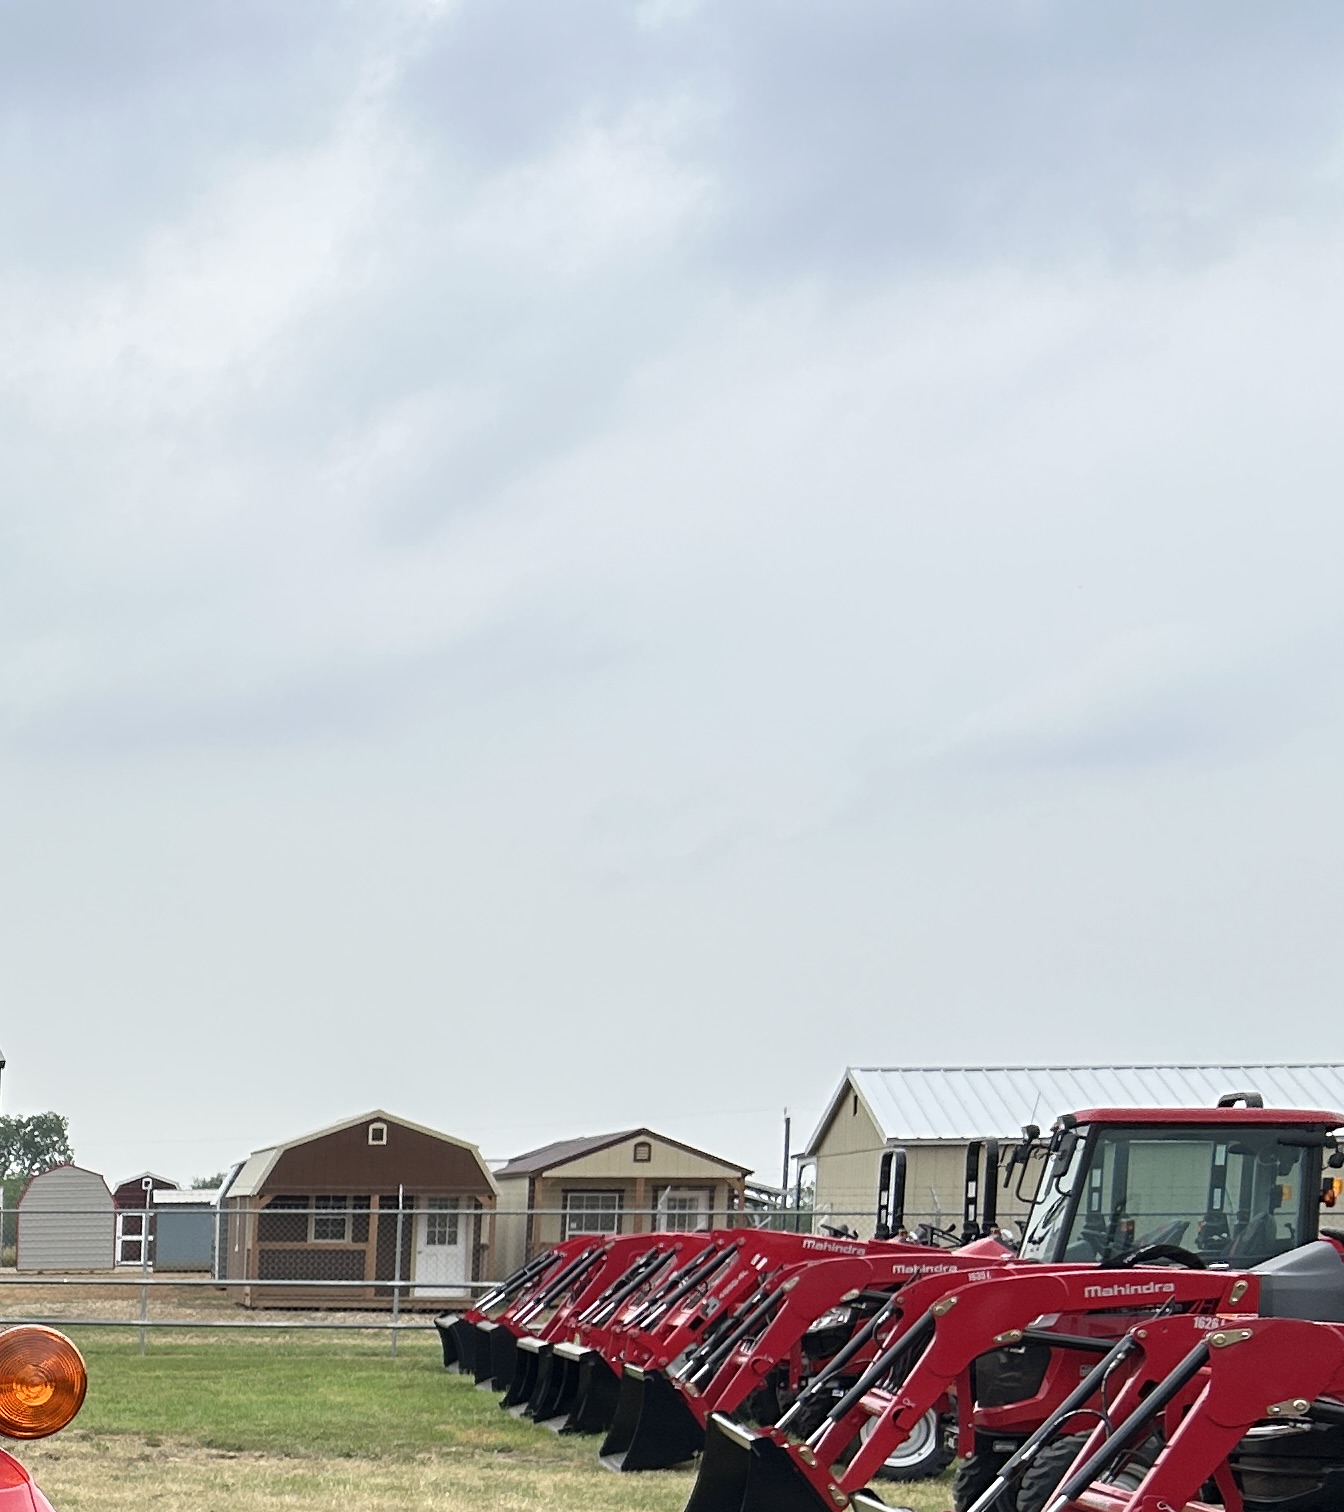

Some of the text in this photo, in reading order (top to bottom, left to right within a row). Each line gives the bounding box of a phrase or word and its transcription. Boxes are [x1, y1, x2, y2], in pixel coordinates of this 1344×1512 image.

[802, 1238, 866, 1256] Mahindra
[892, 1263, 958, 1274] Mahindra
[1084, 1281, 1175, 1298] Mahindra
[1193, 1316, 1219, 1330] 1626
